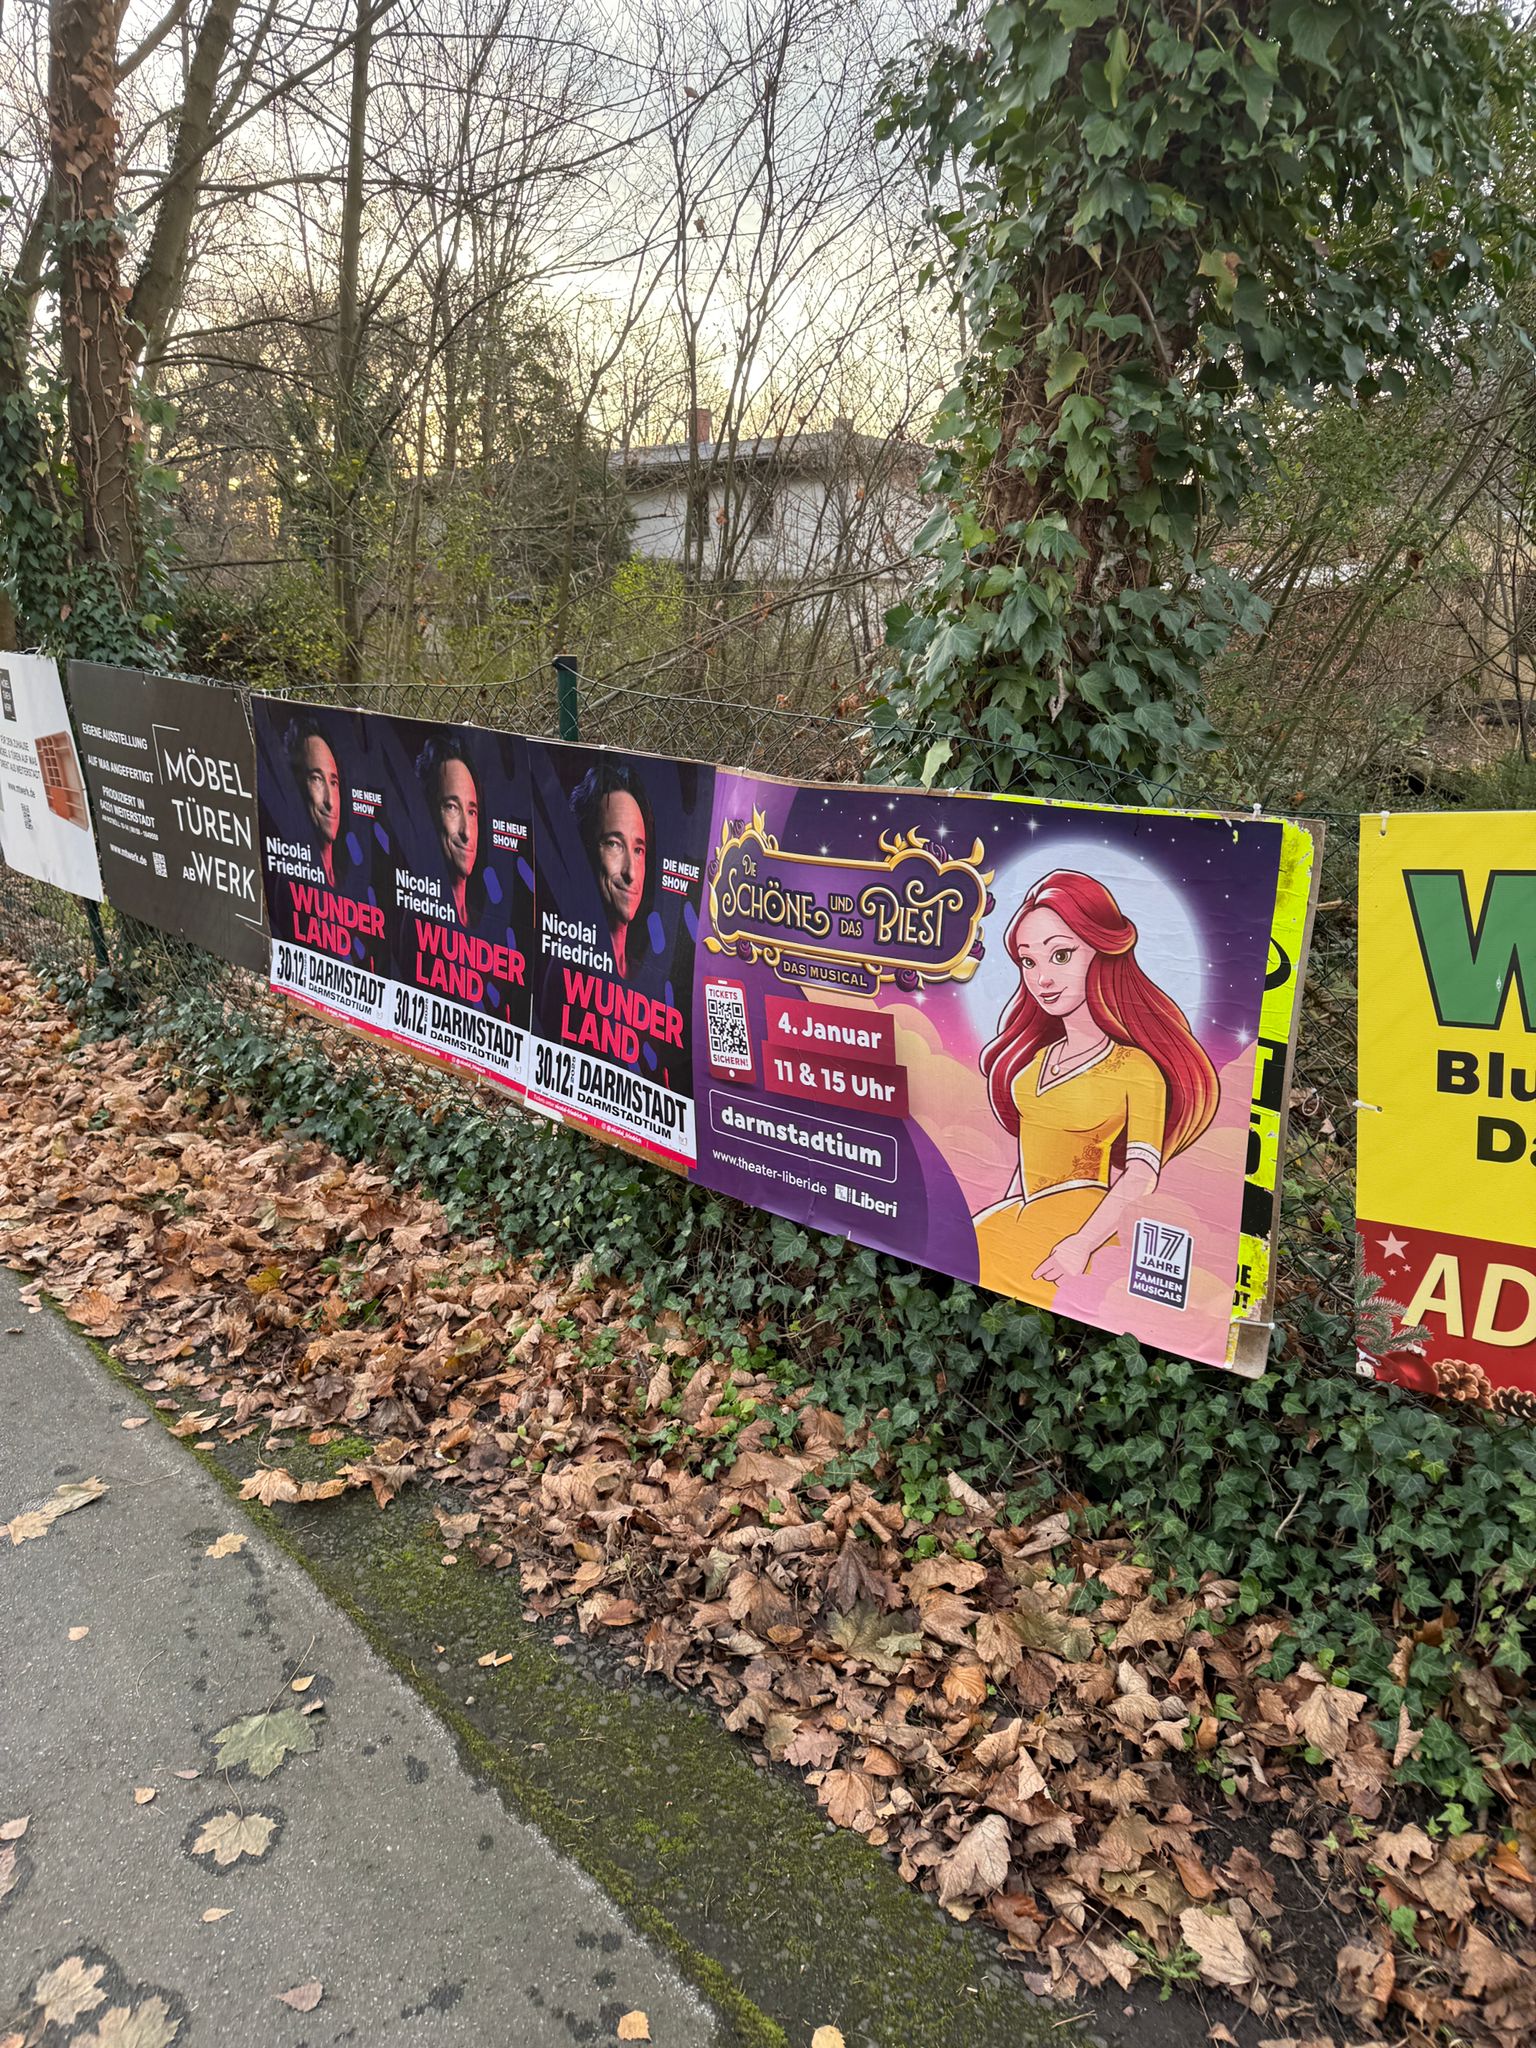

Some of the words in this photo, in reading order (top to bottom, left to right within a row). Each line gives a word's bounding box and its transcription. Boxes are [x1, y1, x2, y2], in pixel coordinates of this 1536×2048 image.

[82, 723, 102, 738] EIGENE
[103, 728, 148, 750] AUSSTELLUNG
[110, 762, 154, 784] ANGEFERTIGT
[164, 747, 252, 799] MÖBEL
[102, 786, 136, 808] PRODUZIERT
[136, 797, 145, 810] IN
[352, 788, 364, 801] DIE
[363, 790, 382, 804] NEUE
[352, 801, 375, 816] SHOW
[113, 803, 155, 828] WEITERSTADT
[171, 796, 252, 850] TÜREN
[492, 818, 505, 832] DIE
[506, 821, 527, 837] NEUE
[266, 836, 311, 862] Nicolai
[493, 833, 518, 850] SHOW
[267, 855, 325, 885] Friedrich
[395, 868, 441, 898] Nicolai
[661, 874, 689, 893] SHOW
[662, 857, 677, 873] DIE
[678, 861, 699, 879] NEUE
[289, 880, 386, 940] WUNDER
[396, 888, 456, 924] Friedrich
[722, 867, 830, 936] SCHÖNE
[830, 895, 853, 912] UND
[840, 919, 863, 937] DAS
[860, 879, 964, 947] BIEST
[293, 911, 351, 957] LAND
[541, 911, 597, 945] Nicolai
[414, 918, 525, 986] WUNDER
[541, 934, 613, 974] Friedrich
[309, 955, 386, 1009] DARMSTADT
[416, 951, 484, 1003] LAND
[782, 961, 807, 976] DAS
[810, 965, 868, 987] MUSICAL
[308, 982, 372, 1015] DARMSTADTIUM
[563, 967, 684, 1049] WUNDER
[708, 988, 738, 1000] TICKETS
[432, 1000, 524, 1062] DARMSTADT
[561, 1004, 639, 1064] LAND
[778, 1012, 798, 1035] 4.
[802, 1017, 882, 1049] Januar
[430, 1030, 509, 1069] DARMSTADTIUM
[712, 1053, 749, 1067] SICHERN!
[579, 1058, 686, 1133] DARMSTADT
[774, 1059, 793, 1083] 11
[799, 1062, 817, 1088] &
[820, 1068, 846, 1093] 15
[851, 1075, 896, 1102] Uhr
[577, 1092, 671, 1140] DARMSTADTIUM
[721, 1106, 882, 1168] darmstadtium
[712, 1149, 827, 1195] www.theater-liberi.de
[851, 1188, 898, 1218] Liberi
[1143, 1222, 1185, 1261] 17
[1135, 1271, 1182, 1293] FAMILIEN
[1140, 1256, 1180, 1275] JAHRE
[1132, 1282, 1182, 1303] MUSICALS
